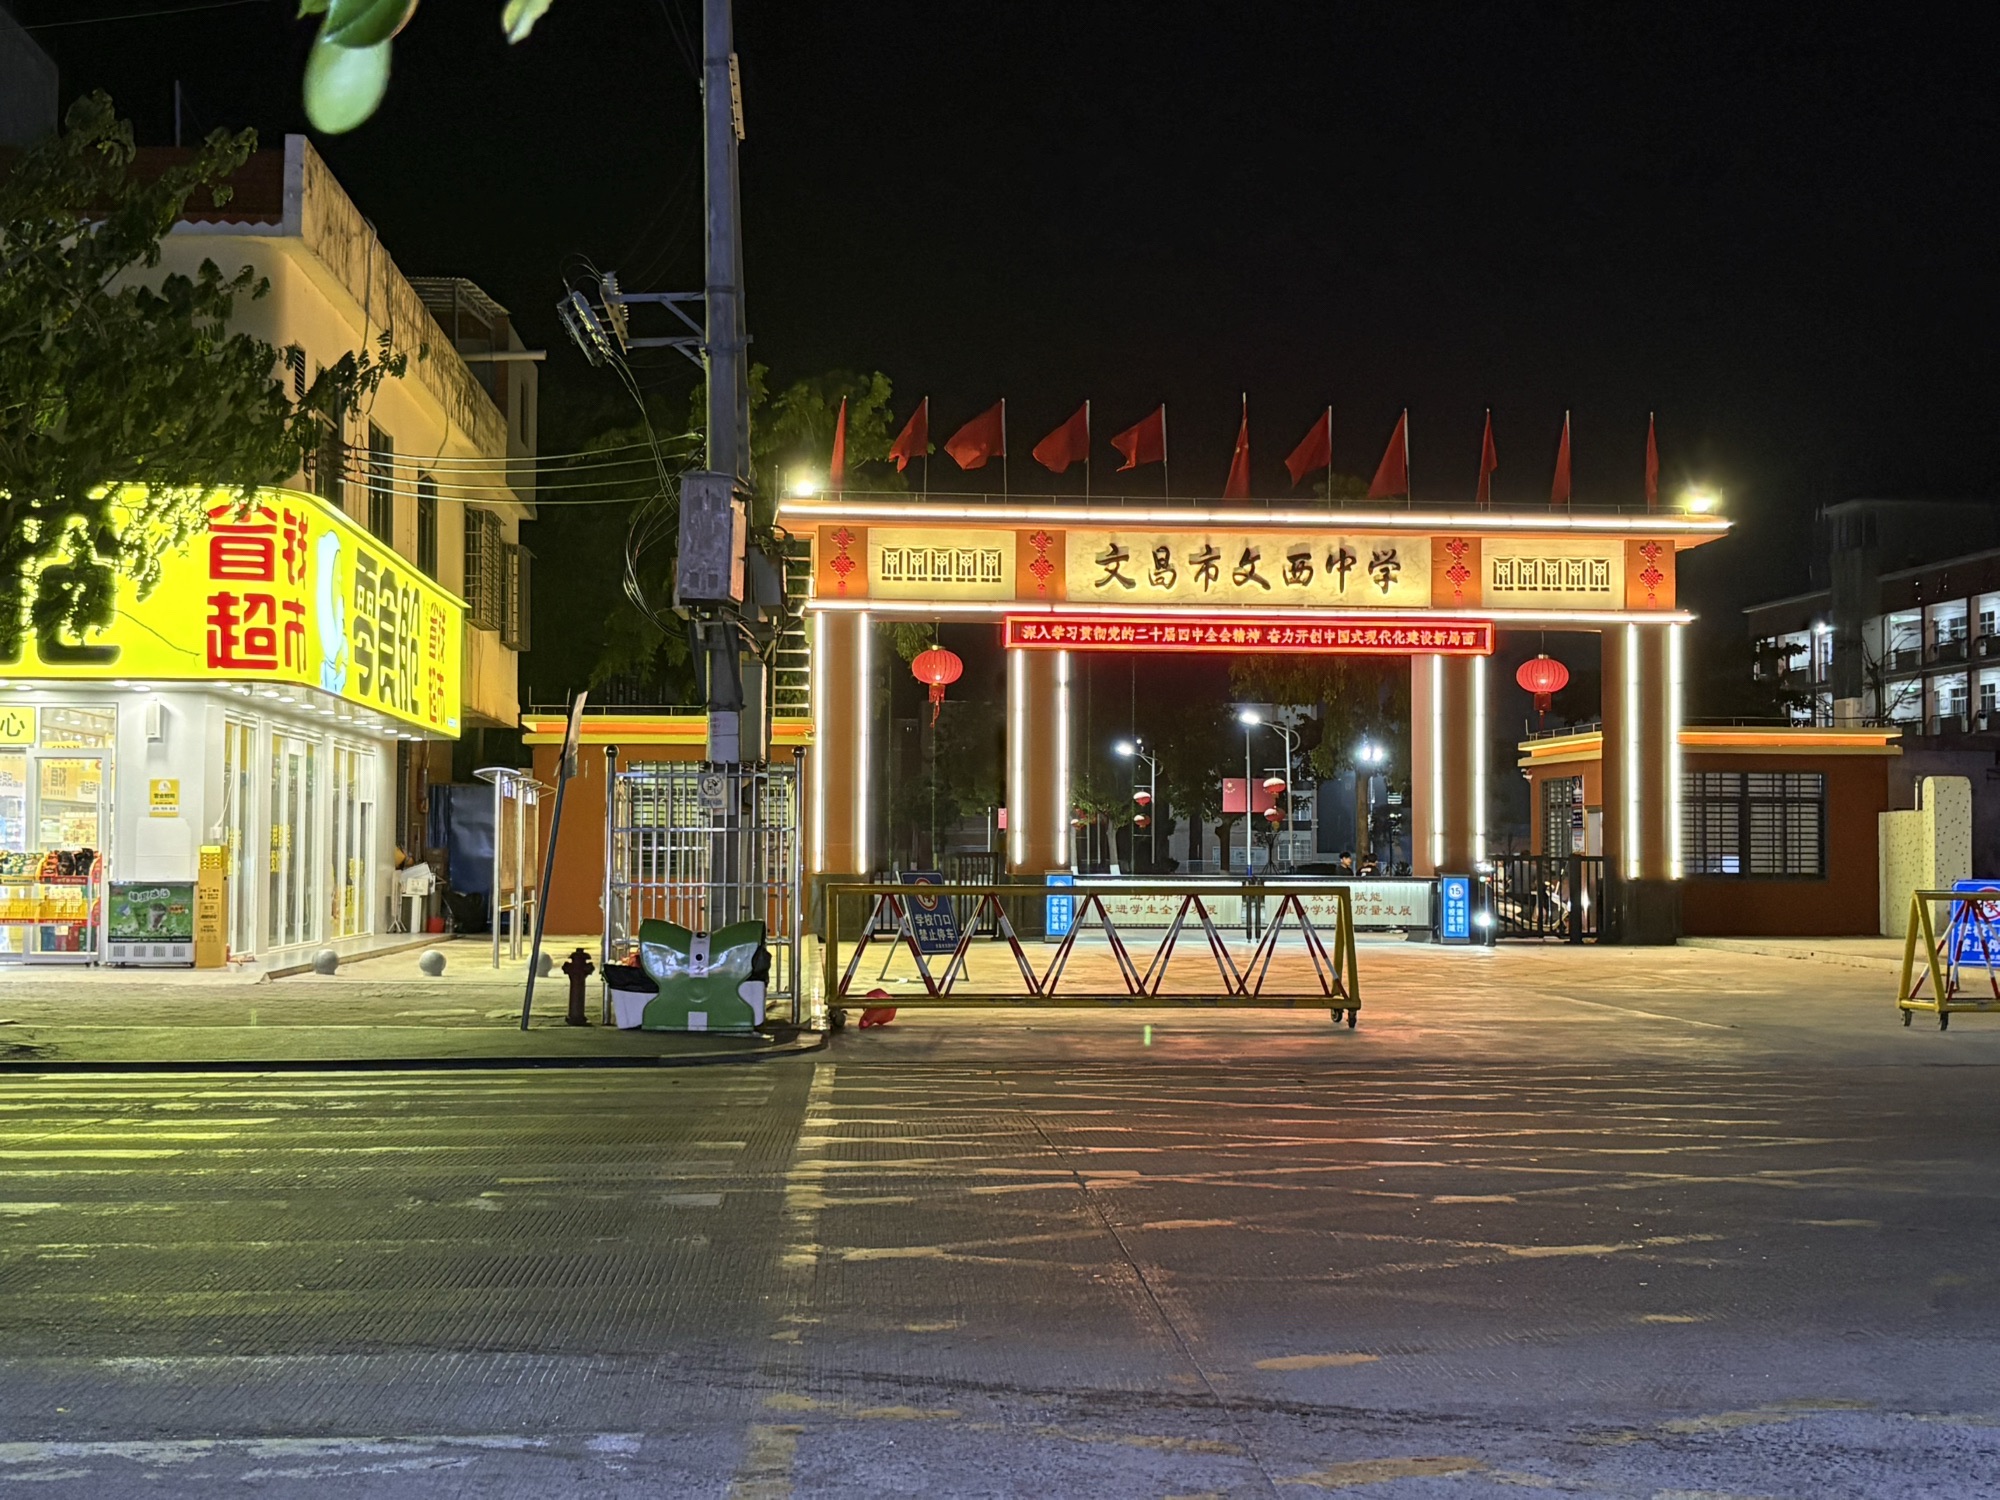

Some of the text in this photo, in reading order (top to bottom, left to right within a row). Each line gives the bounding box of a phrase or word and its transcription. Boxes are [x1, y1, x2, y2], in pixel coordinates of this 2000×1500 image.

[207, 503, 309, 590] 省钱
[1094, 542, 1402, 594] 文昌市文西中学
[206, 591, 307, 675] 超市
[353, 547, 420, 716] 零食舱
[1022, 625, 1476, 646] 深入学习贯彻党的二十届四中全会精神 奋力开创中国式现代化建设新局面
[1450, 887, 1461, 895] 15
[915, 914, 952, 926] 学校门口
[918, 928, 956, 942] 禁止停车
